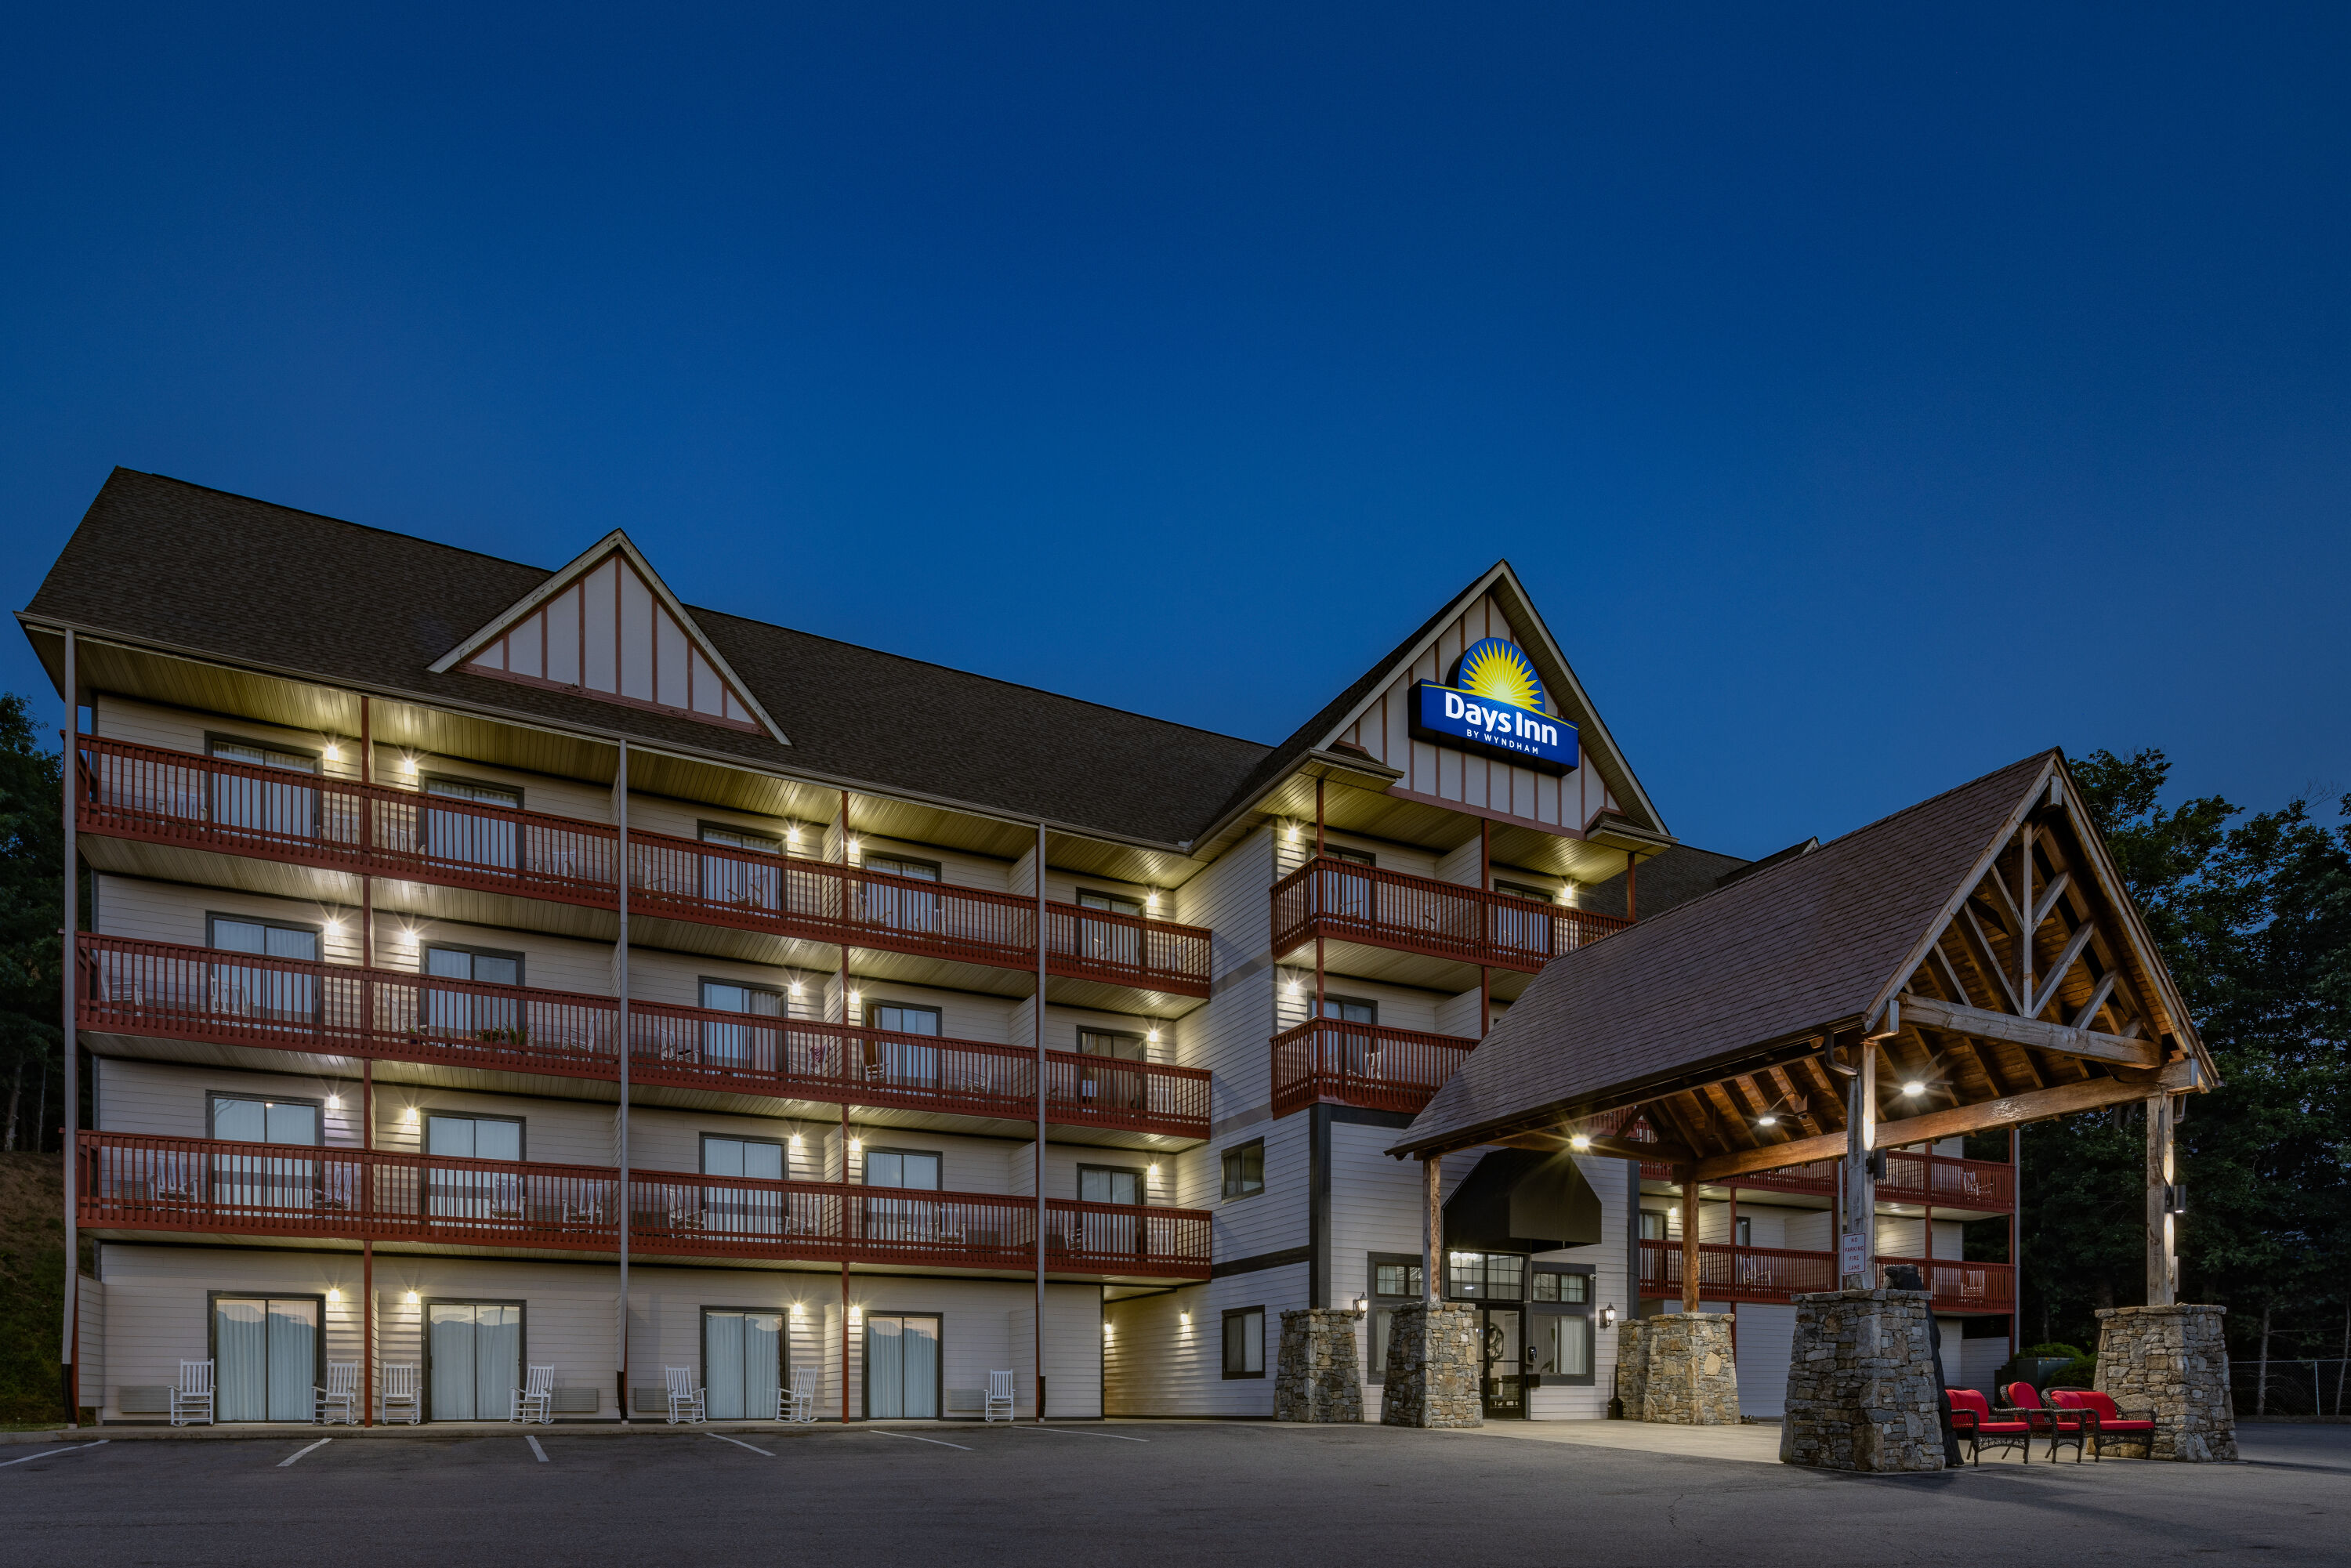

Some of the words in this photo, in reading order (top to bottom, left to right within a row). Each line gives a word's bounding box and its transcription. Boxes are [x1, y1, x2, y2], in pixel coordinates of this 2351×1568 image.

[1445, 692, 1512, 732] Days
[1516, 712, 1558, 747] Inn
[1466, 729, 1479, 739] BY
[1484, 733, 1538, 755] WYNDHAM
